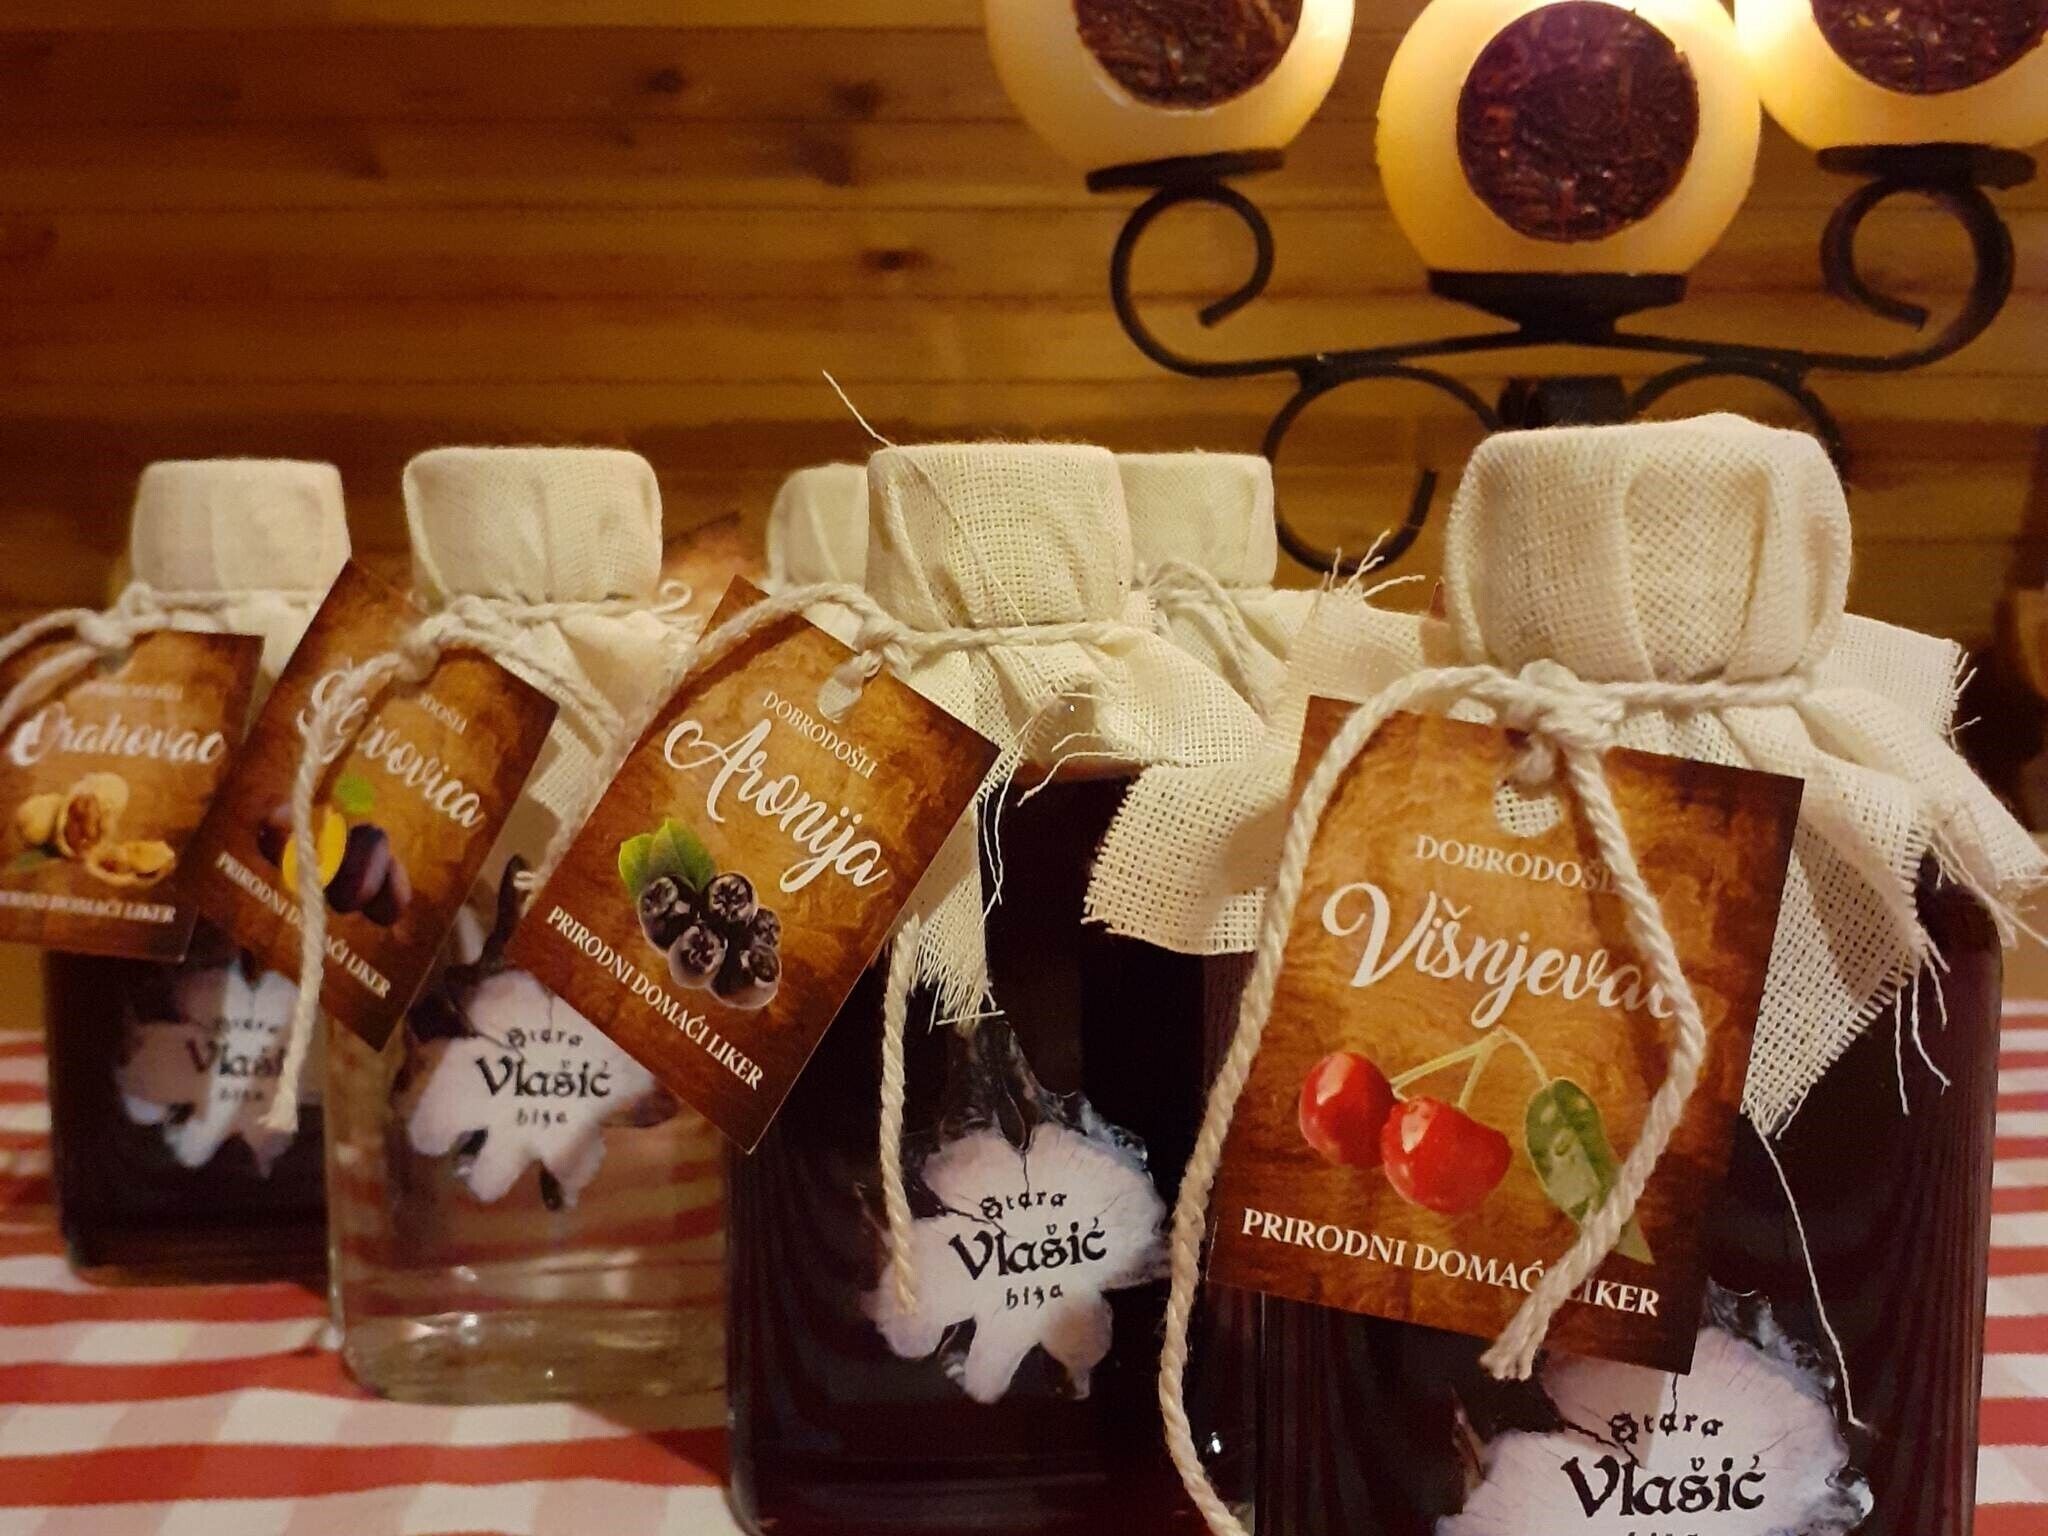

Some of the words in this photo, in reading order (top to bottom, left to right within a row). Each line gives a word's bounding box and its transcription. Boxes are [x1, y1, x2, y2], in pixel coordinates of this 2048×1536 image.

[762, 691, 879, 780] DOBRODOŠLI
[664, 718, 889, 893] Aronija
[1415, 834, 1618, 894] DOBRODOŠL
[547, 905, 635, 984] PRIRODNI
[631, 978, 711, 1045] DOMAĆI
[705, 1034, 764, 1091] LIKER
[475, 1055, 613, 1098] Vlašić
[979, 1189, 1068, 1220] Stara
[948, 1216, 1108, 1281] Vlašić
[1241, 1207, 1407, 1265] PRIRODNI
[1412, 1243, 1546, 1293] DOMAĆ
[1608, 1412, 1724, 1444] Stara
[1560, 1454, 1767, 1518] Vlašić
